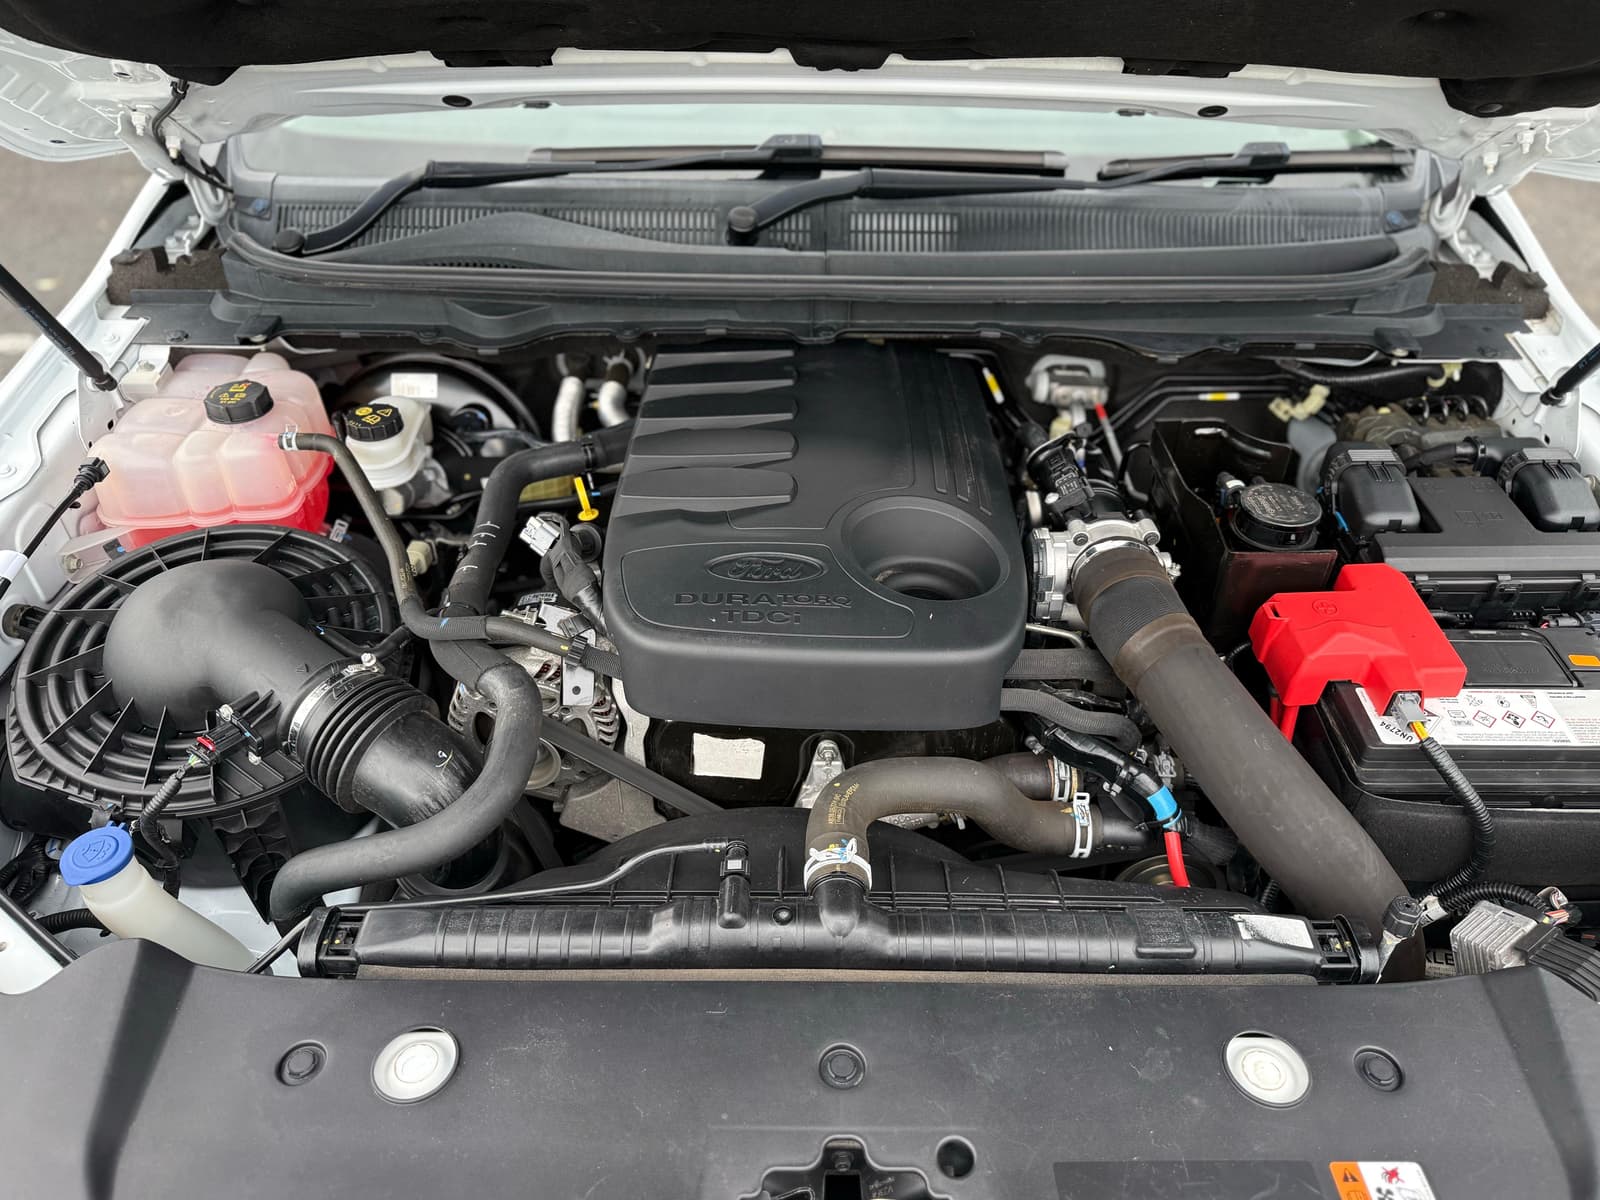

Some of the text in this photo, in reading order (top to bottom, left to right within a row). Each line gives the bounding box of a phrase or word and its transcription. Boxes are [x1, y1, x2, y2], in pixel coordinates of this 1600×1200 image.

[727, 556, 802, 579] Ford
[674, 592, 852, 609] DURATORQ
[720, 609, 801, 625] TDCi
[1379, 720, 1414, 743] UN2794
